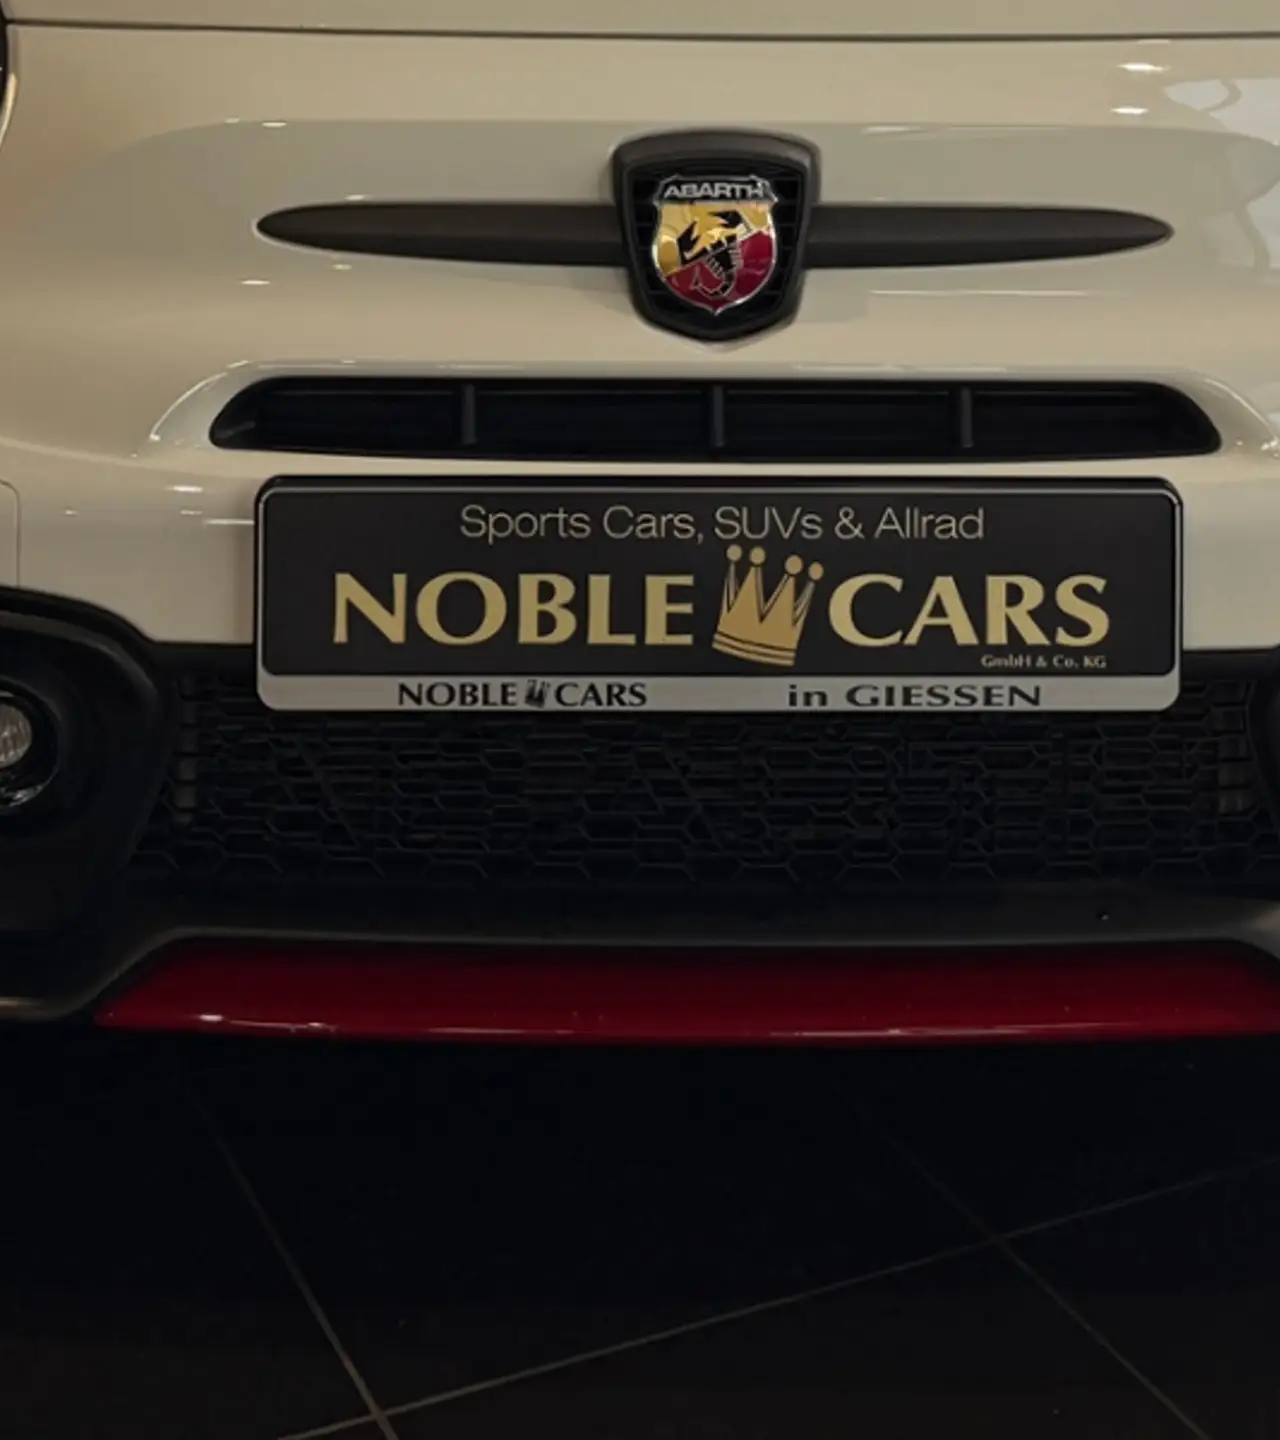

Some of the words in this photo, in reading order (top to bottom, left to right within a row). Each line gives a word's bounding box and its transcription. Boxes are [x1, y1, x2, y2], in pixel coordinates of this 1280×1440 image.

[663, 182, 764, 199] ABARTH
[459, 504, 591, 544] Sports
[603, 505, 705, 544] Cars,
[714, 506, 823, 540] SUVs
[834, 507, 865, 540] &
[875, 506, 985, 540] Allrad
[333, 572, 695, 646] NOBLE
[828, 573, 1110, 648] CARS
[981, 655, 1031, 669] GmbH
[1036, 656, 1048, 669] &
[1053, 655, 1079, 669] Co.
[1083, 656, 1107, 669] KG
[398, 682, 517, 707] NOBLE
[555, 682, 647, 708] CARS
[788, 684, 828, 707] in
[846, 685, 1040, 708] GIESSEN
